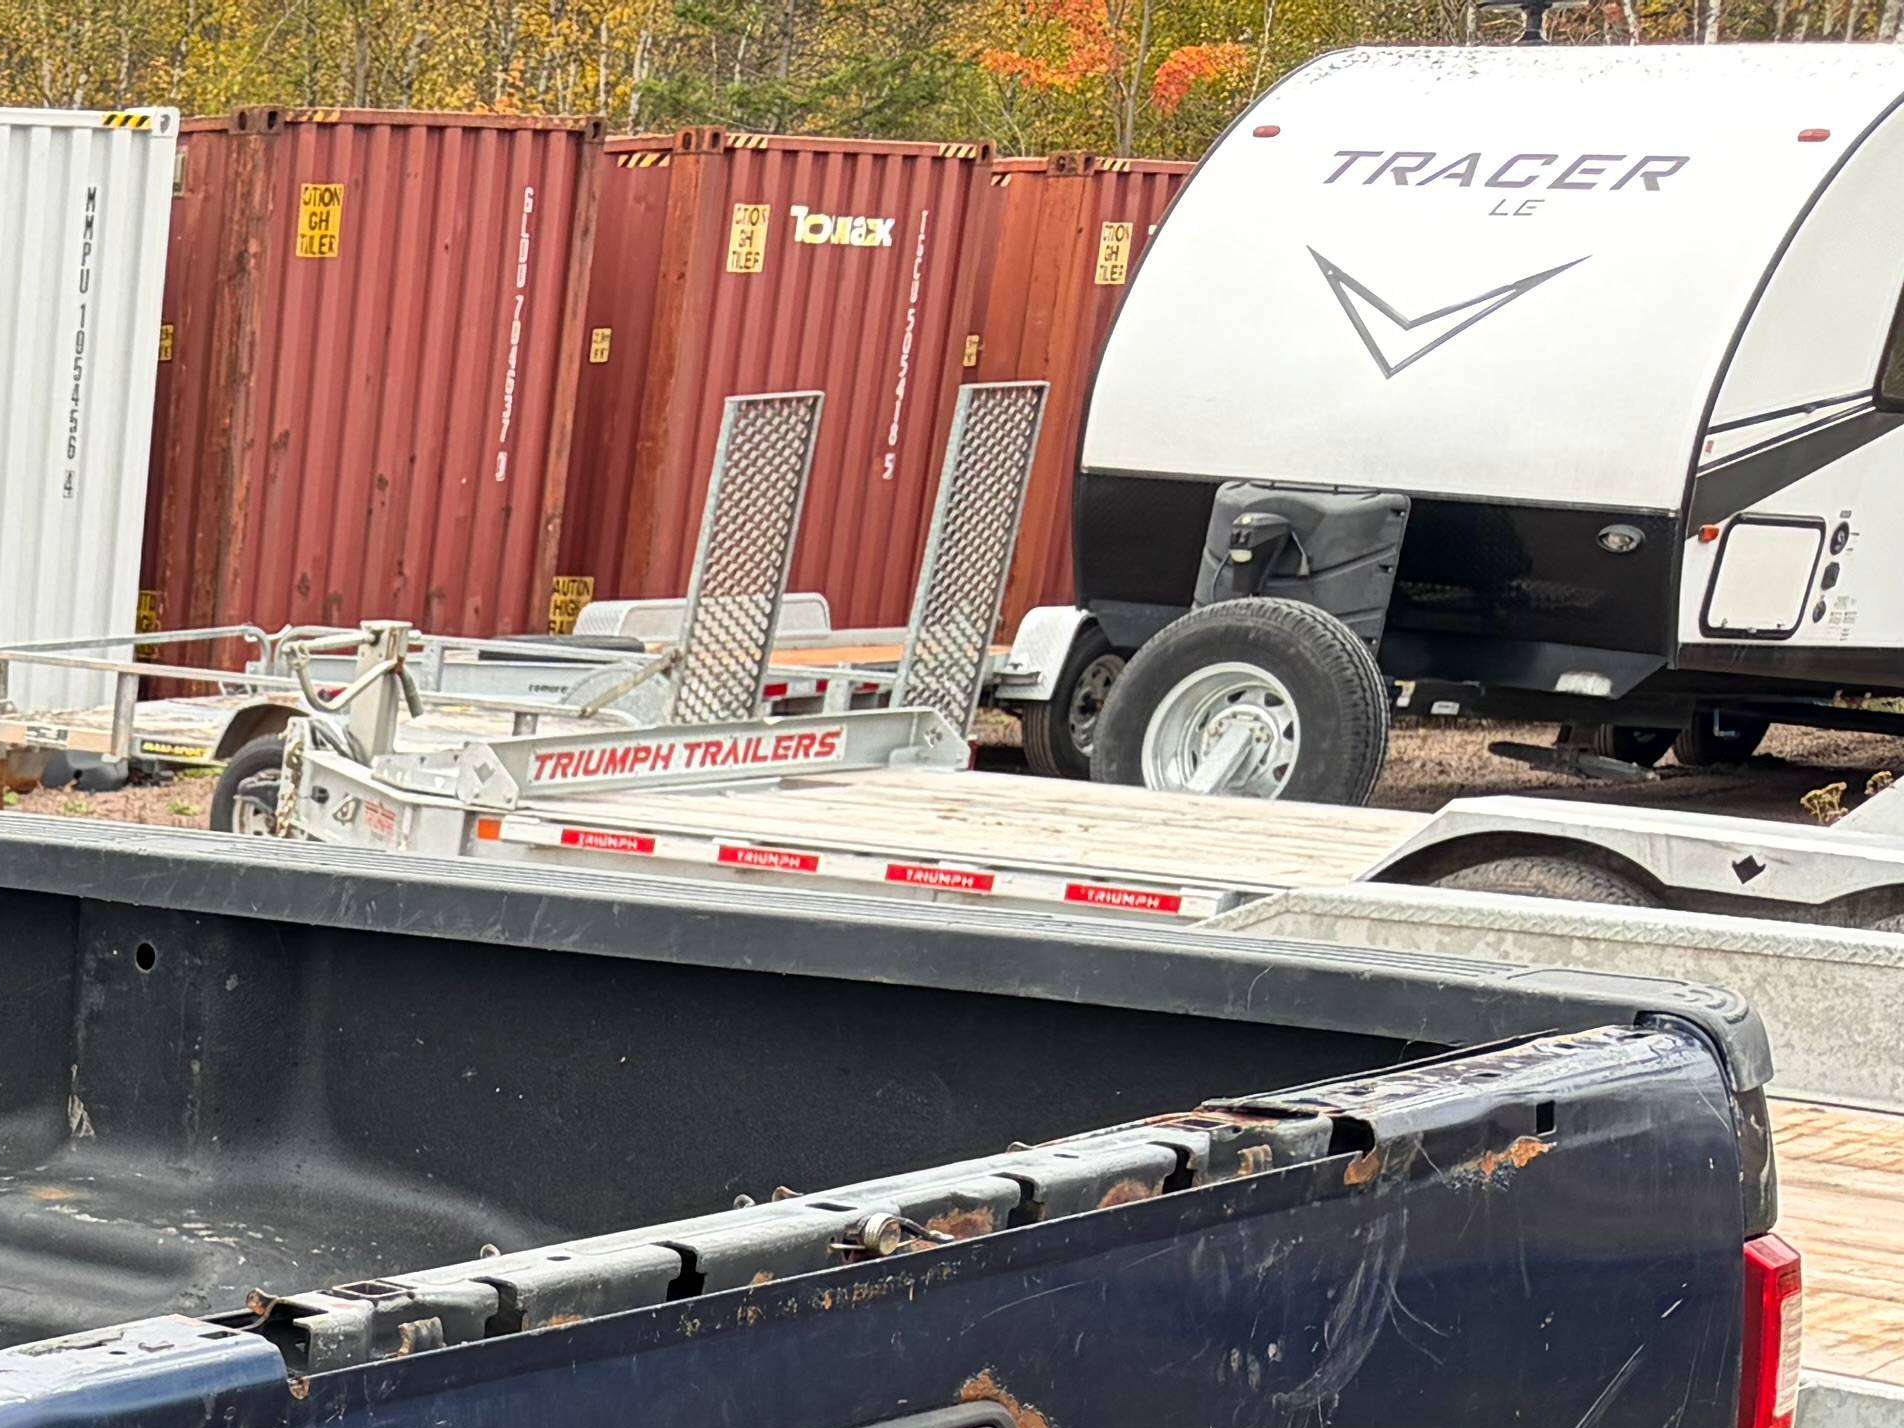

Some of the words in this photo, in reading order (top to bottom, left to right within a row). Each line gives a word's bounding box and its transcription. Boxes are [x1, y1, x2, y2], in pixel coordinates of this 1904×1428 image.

[1323, 150, 1691, 192] TRACER
[1488, 199, 1546, 216] LE
[533, 741, 676, 780] TRIUMPH
[683, 730, 842, 769] TRAILERS
[736, 850, 801, 868] TRIUMPH
[905, 869, 975, 887] TRIUMPH
[1086, 889, 1160, 908] TRIUMPH
